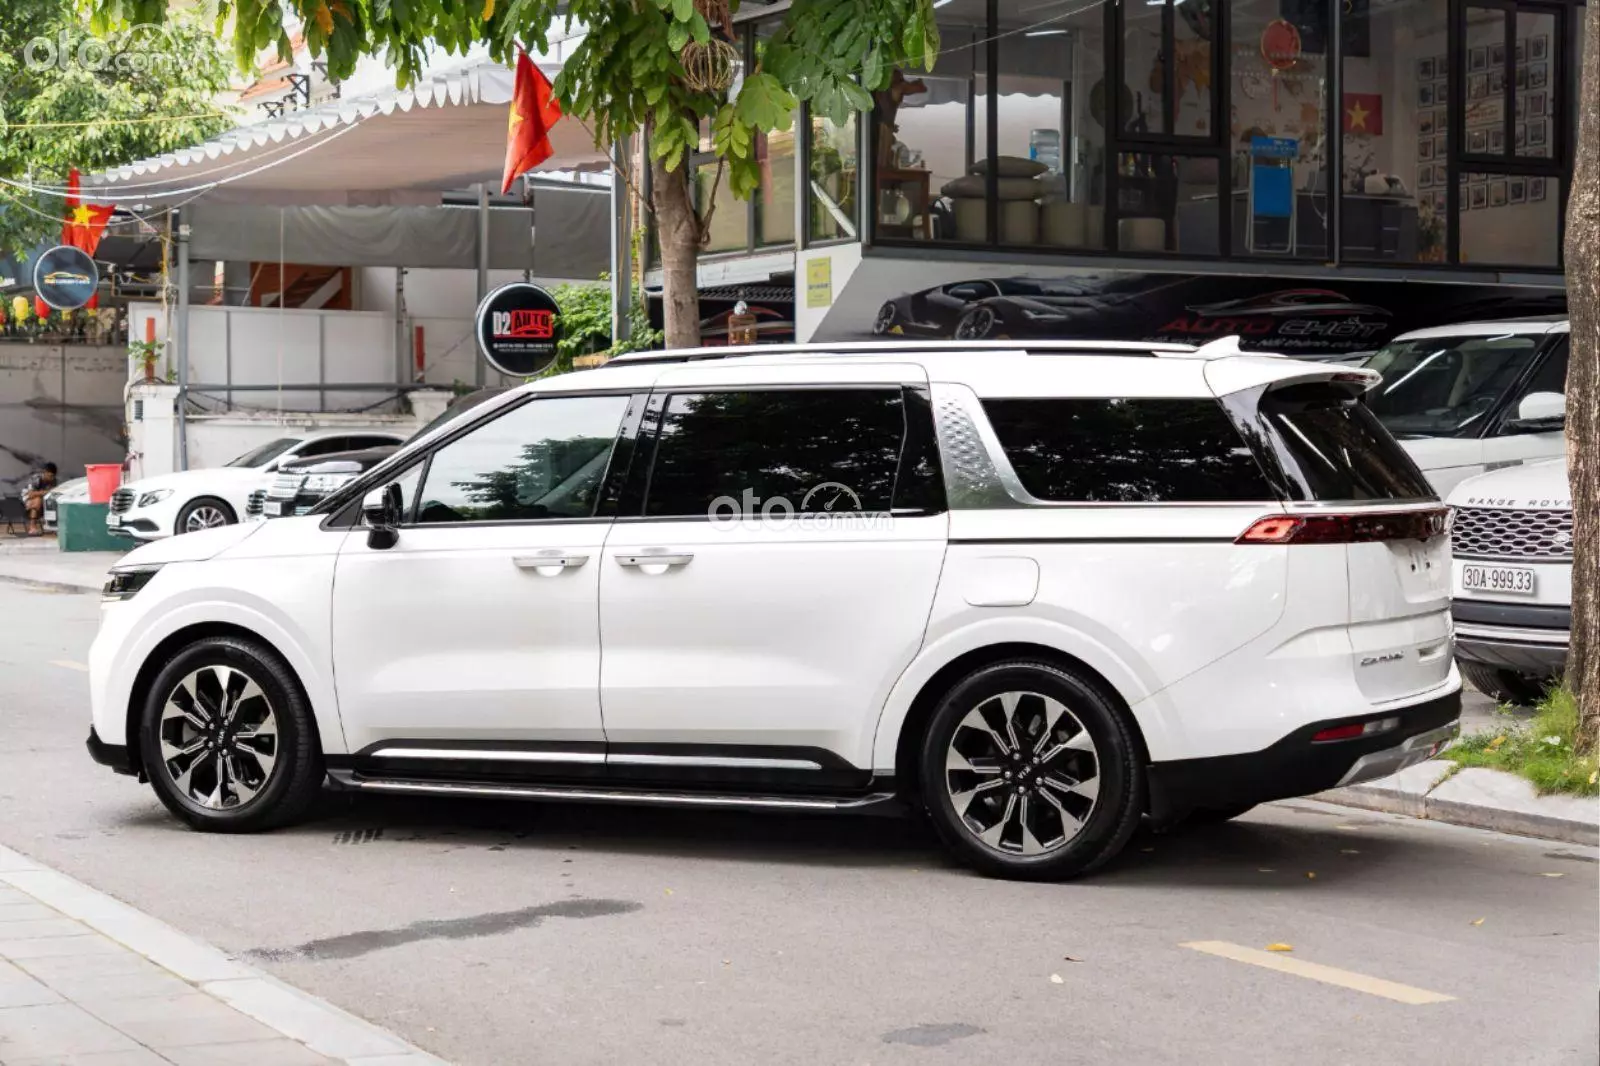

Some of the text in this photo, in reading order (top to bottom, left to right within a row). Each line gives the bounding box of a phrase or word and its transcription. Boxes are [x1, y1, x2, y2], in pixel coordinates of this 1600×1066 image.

[492, 310, 552, 335] D2 AUTO
[1158, 315, 1274, 334] AUTO
[1467, 497, 1516, 506] RANGE
[1465, 568, 1532, 590] 30A-999.33
